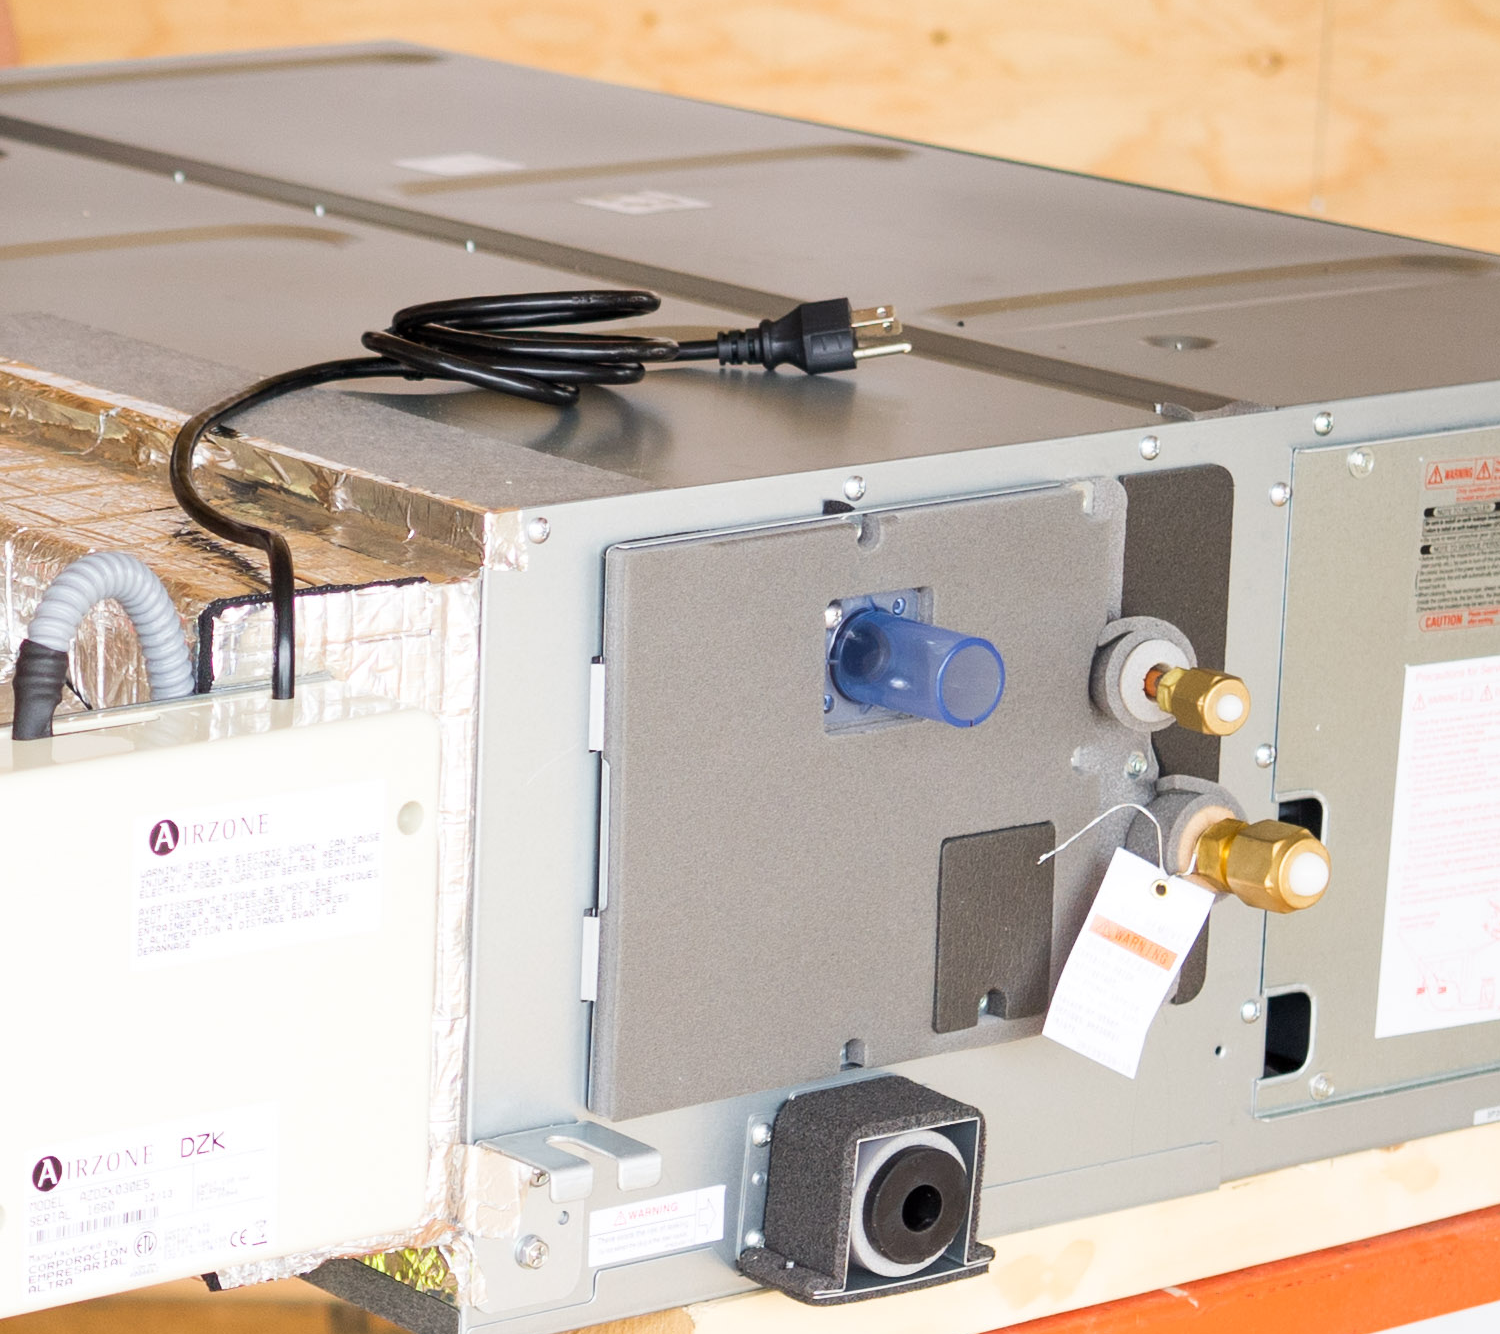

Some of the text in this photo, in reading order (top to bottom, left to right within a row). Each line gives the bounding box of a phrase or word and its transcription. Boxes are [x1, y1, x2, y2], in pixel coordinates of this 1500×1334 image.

[1425, 615, 1462, 628] CAUTION
[149, 814, 269, 856] AIRZONE
[1113, 927, 1169, 966] WARNING
[32, 1144, 153, 1192] AIRZONE
[180, 1131, 225, 1158] DZK
[628, 1202, 679, 1220] WARNING
[28, 1247, 128, 1274] CORPORACION
[28, 1258, 127, 1285] EMPRESARIAL
[28, 1277, 73, 1294] ALTRA
